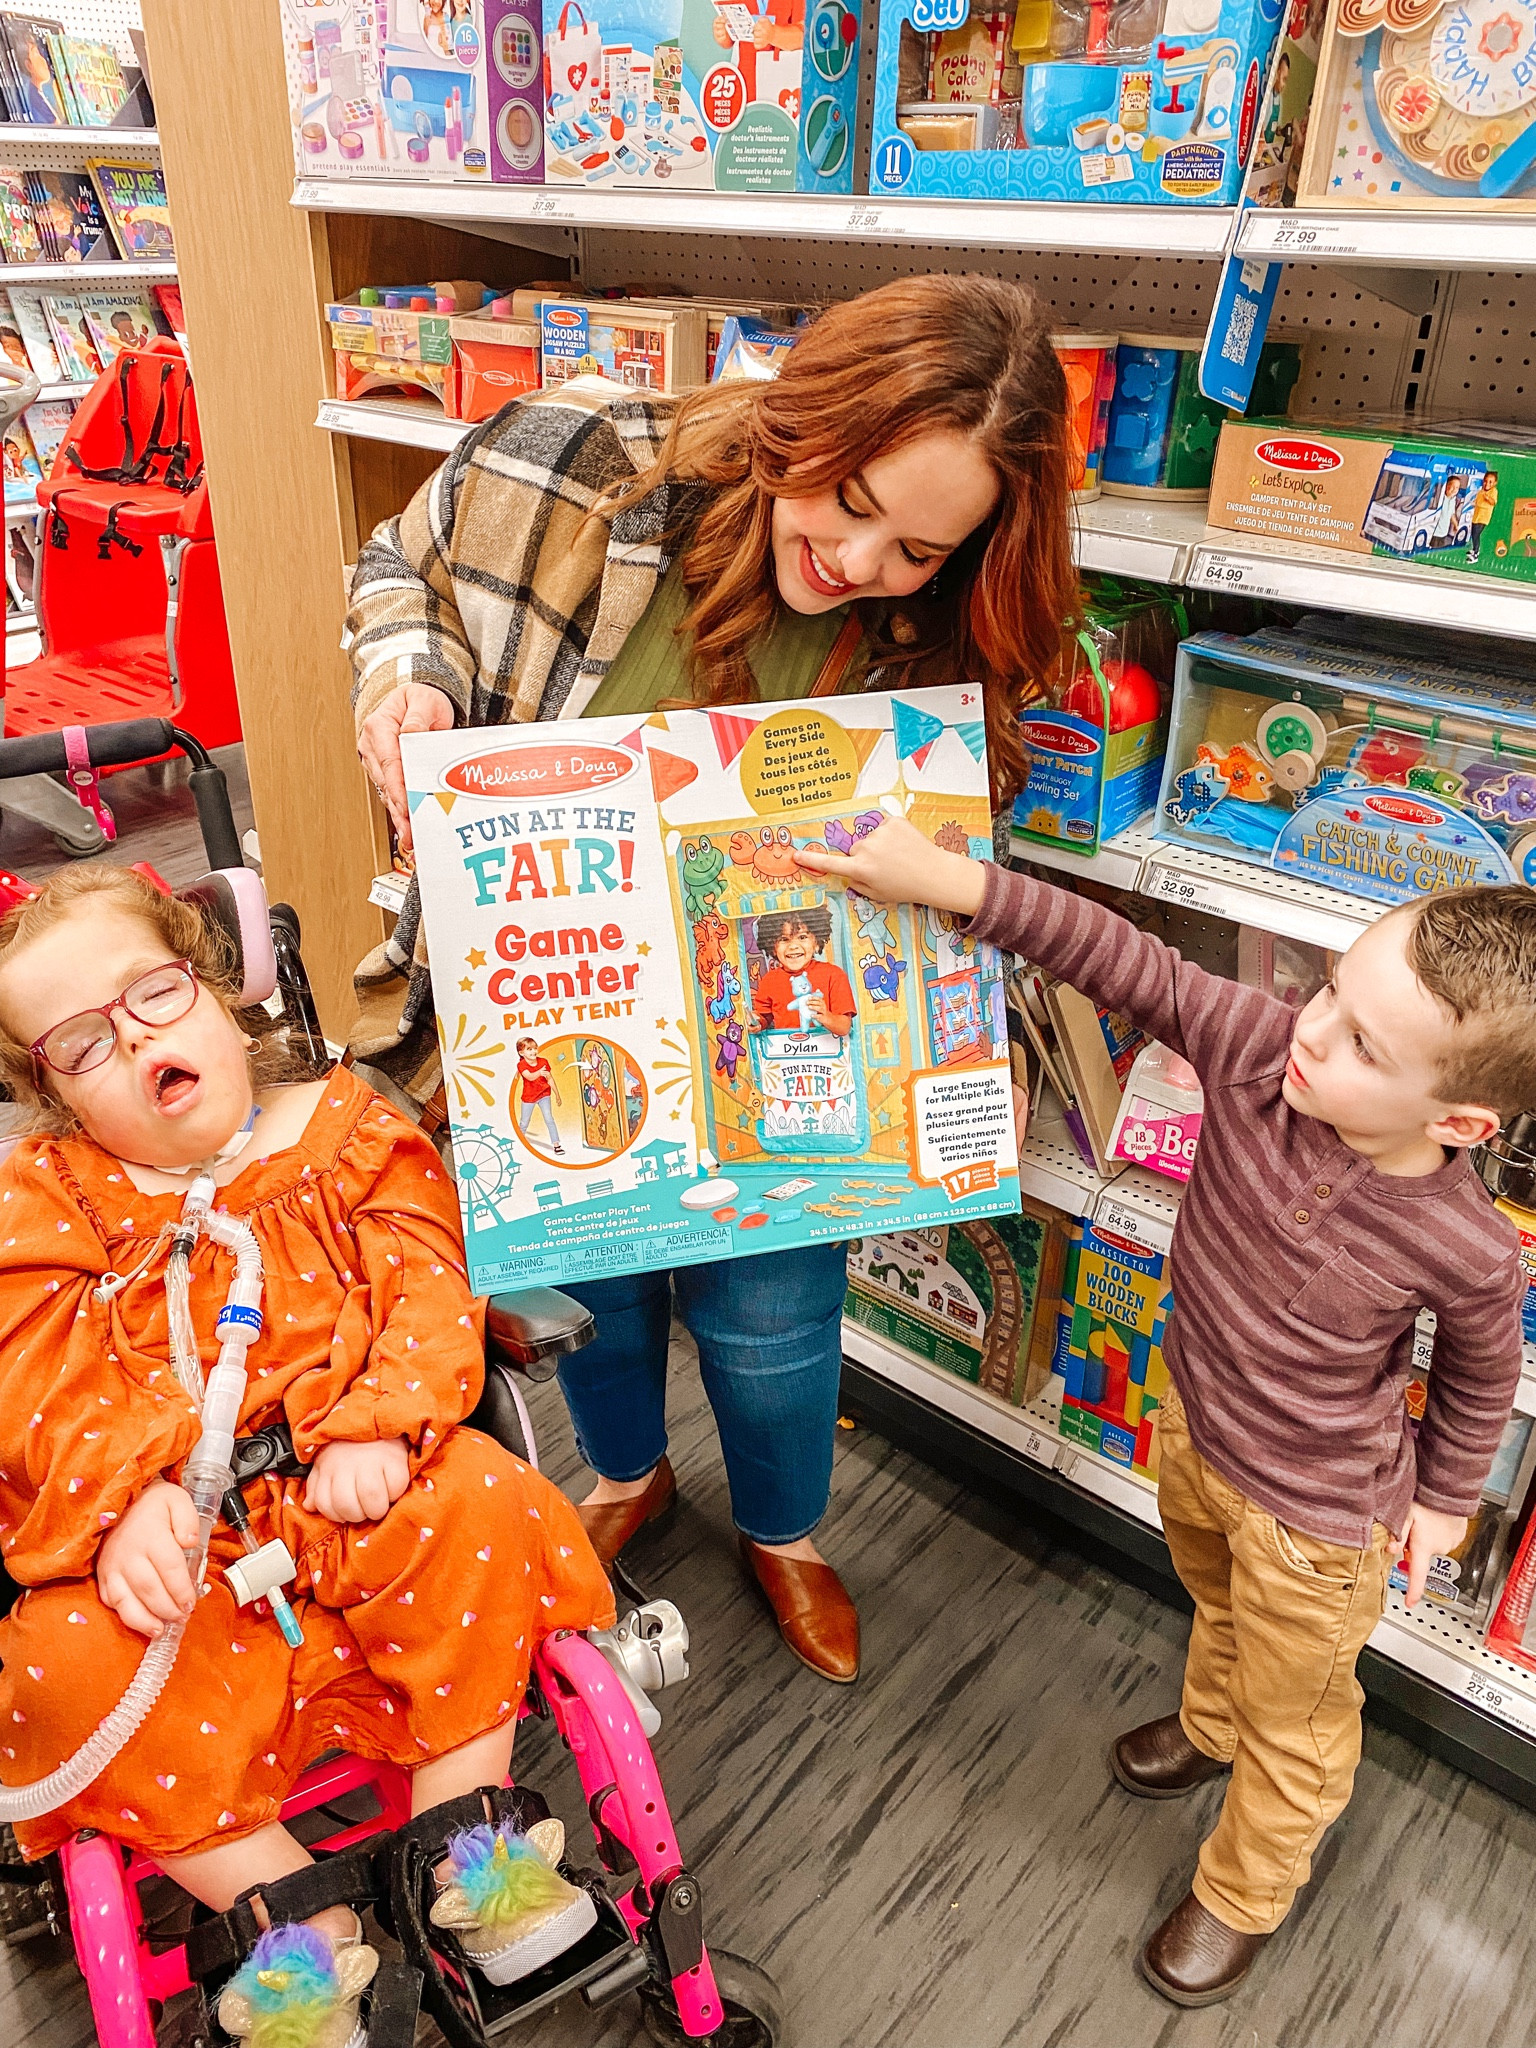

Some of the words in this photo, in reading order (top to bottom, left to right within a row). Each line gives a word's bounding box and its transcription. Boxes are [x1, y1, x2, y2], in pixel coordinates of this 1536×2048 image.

[461, 30, 472, 43] 16
[458, 46, 477, 57] pieces
[711, 74, 736, 98] 25
[947, 70, 979, 87] Cake
[747, 125, 773, 133] Realistic
[884, 144, 901, 175] 11
[1170, 146, 1219, 159] PARTNERING
[312, 163, 338, 172] pretend
[355, 165, 391, 173] essentials
[1165, 168, 1220, 180] PEDIATRICS
[112, 171, 135, 190] YOU
[136, 172, 160, 191] ARE
[883, 174, 903, 183] PIECES
[79, 185, 93, 200] My
[110, 189, 134, 206] NOT
[136, 190, 167, 207] ALONE
[532, 201, 555, 211] 37.99
[848, 214, 878, 227] 37.99
[1273, 231, 1317, 243] 27.99
[106, 295, 143, 306] AMAZING!
[543, 327, 586, 341] WOODEN
[746, 333, 778, 344] CLASSIC
[544, 339, 564, 347] JIGSAW
[564, 341, 586, 349] PUZZLES
[322, 413, 340, 423] 22.99
[1263, 444, 1301, 461] Melissa
[1303, 451, 1309, 461] &
[1310, 452, 1334, 469] Doug
[1250, 493, 1280, 506] CAMPER
[1281, 498, 1298, 508] TENT
[1298, 501, 1318, 512] PLAY
[1318, 504, 1333, 514] SET
[1226, 502, 1261, 516] ENSEMBLE
[1261, 507, 1271, 517] DE
[1271, 509, 1285, 519] JEU
[1286, 512, 1308, 524] TENTE
[1308, 515, 1318, 525] DE
[1320, 517, 1355, 531] CAMPING
[1234, 516, 1257, 528] JUEGO
[1257, 520, 1267, 529] DE
[1268, 522, 1292, 534] TIENDA
[1293, 526, 1303, 536] DE
[1304, 527, 1340, 543] CAMPAÑA
[1210, 554, 1227, 563] M&D
[1206, 566, 1243, 582] 64.99
[960, 693, 976, 706] 3+
[763, 725, 805, 740] Games
[806, 721, 821, 730] on
[1023, 724, 1058, 742] Melissa
[1067, 735, 1089, 753] Doug
[765, 737, 797, 751] Every
[799, 731, 826, 744] Side
[764, 755, 787, 767] Des
[787, 751, 814, 766] jeux
[815, 747, 830, 757] de
[460, 764, 547, 790] Melissa
[554, 760, 565, 775] &
[570, 757, 619, 783] Doug
[760, 767, 787, 780] tous
[788, 763, 805, 775] les
[807, 757, 838, 771] côtés
[754, 782, 796, 798] Juegos
[798, 777, 818, 792] por
[819, 770, 852, 784] todos
[1026, 780, 1060, 799] owling
[1063, 788, 1080, 801] Set
[782, 795, 799, 807] los
[801, 788, 833, 803] lados
[1371, 798, 1407, 815] Melissa
[1415, 809, 1437, 824] Doug
[455, 812, 521, 849] FUN
[528, 808, 567, 833] AT
[573, 807, 637, 834] THE
[1316, 819, 1380, 851] CATCH
[1385, 825, 1403, 857] &
[1407, 843, 1483, 877] COUNT
[1301, 833, 1409, 884] FISHING
[463, 837, 636, 907] FAIR!
[1166, 870, 1181, 878] M&D
[375, 891, 391, 904] 42.99
[1161, 880, 1195, 898] 32.99
[495, 923, 626, 963] Game
[487, 959, 640, 1006] Center
[503, 1007, 566, 1031] PLAY
[572, 999, 636, 1022] TENT
[784, 1041, 818, 1056] Dylan
[781, 1064, 801, 1077] FUN
[801, 1064, 814, 1073] AT
[814, 1064, 832, 1076] THE
[783, 1075, 832, 1097] FAIR!
[932, 1084, 959, 1094] Large
[961, 1078, 997, 1091] Enough
[925, 1097, 940, 1105] for
[941, 1091, 982, 1103] Multiple
[984, 1087, 1005, 1097] Kids
[925, 1110, 954, 1120] Assez
[955, 1105, 984, 1117] grand
[986, 1103, 1008, 1113] pour
[926, 1117, 970, 1131] plusieurs
[972, 1112, 1008, 1124] enfants
[928, 1127, 1007, 1145] Suficientemente
[1135, 1131, 1147, 1143] 18
[939, 1141, 973, 1155] grande
[974, 1139, 997, 1150] para
[941, 1152, 970, 1162] varios
[972, 1149, 998, 1159] niños
[1130, 1143, 1152, 1151] Pieces
[1158, 1159, 1181, 1173] Wooden
[949, 1170, 971, 1194] 17
[543, 1216, 573, 1227] Game
[575, 1211, 606, 1224] Center
[608, 1207, 629, 1221] Play
[630, 1203, 651, 1214] Tent
[1111, 1204, 1125, 1213] M&D
[546, 1226, 573, 1237] Tente
[574, 1222, 604, 1234] centre
[605, 1219, 618, 1230] de
[618, 1216, 640, 1228] jeux
[809, 1228, 828, 1237] 34.5
[829, 1226, 838, 1234] in
[845, 1222, 864, 1231] 48.3
[865, 1220, 874, 1228] in
[883, 1217, 901, 1226] 34.5
[902, 1215, 911, 1223] in
[929, 1211, 942, 1219] cm
[1108, 1213, 1138, 1233] 64.99
[507, 1241, 541, 1254] Tienda
[542, 1238, 554, 1248] de
[555, 1232, 601, 1249] campaña
[601, 1229, 614, 1240] de
[615, 1225, 645, 1238] centro
[646, 1222, 658, 1232] de
[658, 1218, 690, 1234] juegos
[666, 1229, 730, 1246] ADVERTENCIA:
[584, 1244, 634, 1259] ATTENTION
[1089, 1241, 1129, 1265] CLASSIC
[1132, 1259, 1151, 1274] TOY
[499, 1256, 547, 1273] WARNING:
[477, 1273, 498, 1284] ADULT
[498, 1270, 527, 1281] ASSEMBLY
[527, 1264, 559, 1276] REQUIRED
[1102, 1261, 1132, 1287] 100
[1086, 1271, 1146, 1312] WOODEN
[1087, 1290, 1138, 1327] BLOCKS
[1062, 1323, 1072, 1341] TOY
[1058, 1340, 1069, 1371] CLASSIC
[1429, 1565, 1452, 1579] Pieces
[1436, 1557, 1452, 1571] 12
[1472, 1671, 1487, 1683] M&D
[1466, 1681, 1503, 1706] 27.99
